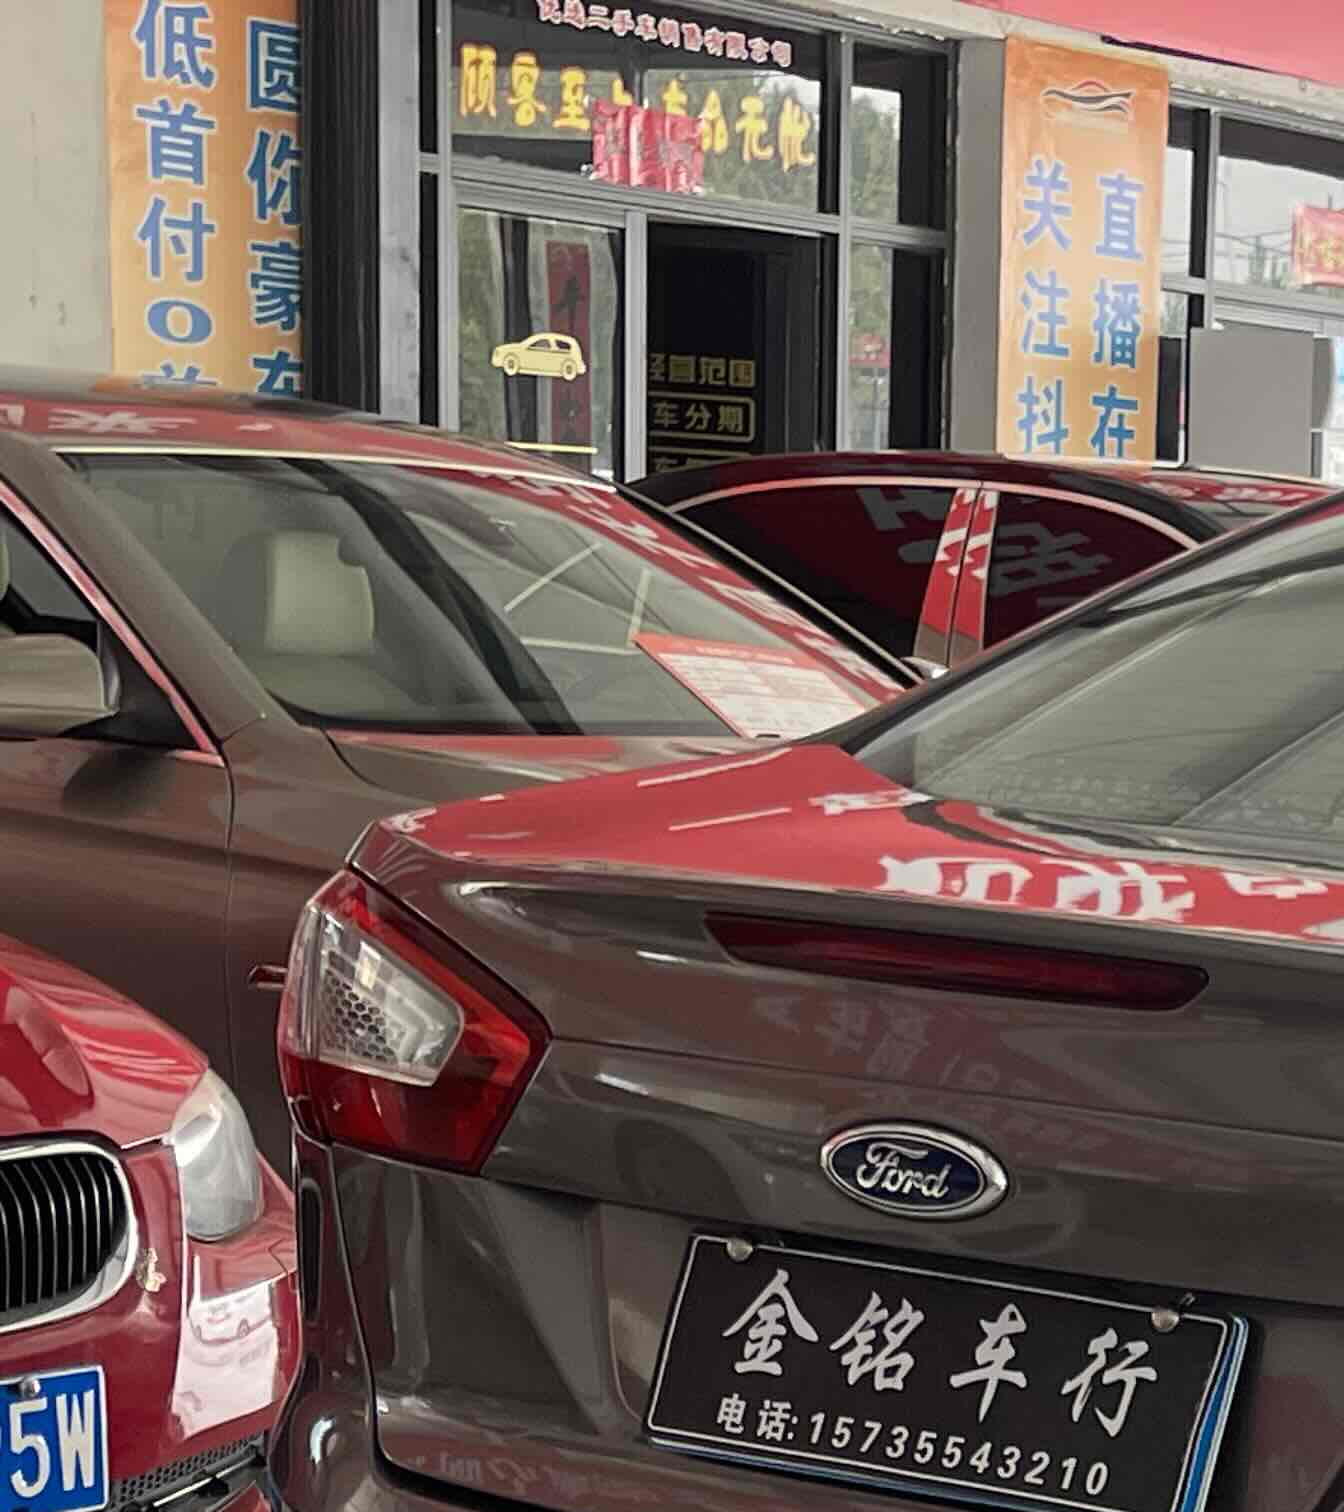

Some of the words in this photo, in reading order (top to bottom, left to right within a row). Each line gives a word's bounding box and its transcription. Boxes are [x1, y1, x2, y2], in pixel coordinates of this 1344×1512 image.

[1017, 158, 1073, 456] 关注抖
[1090, 172, 1145, 458] 直播在
[856, 1142, 953, 1199] Ford
[721, 1268, 1159, 1438] 金铭车行
